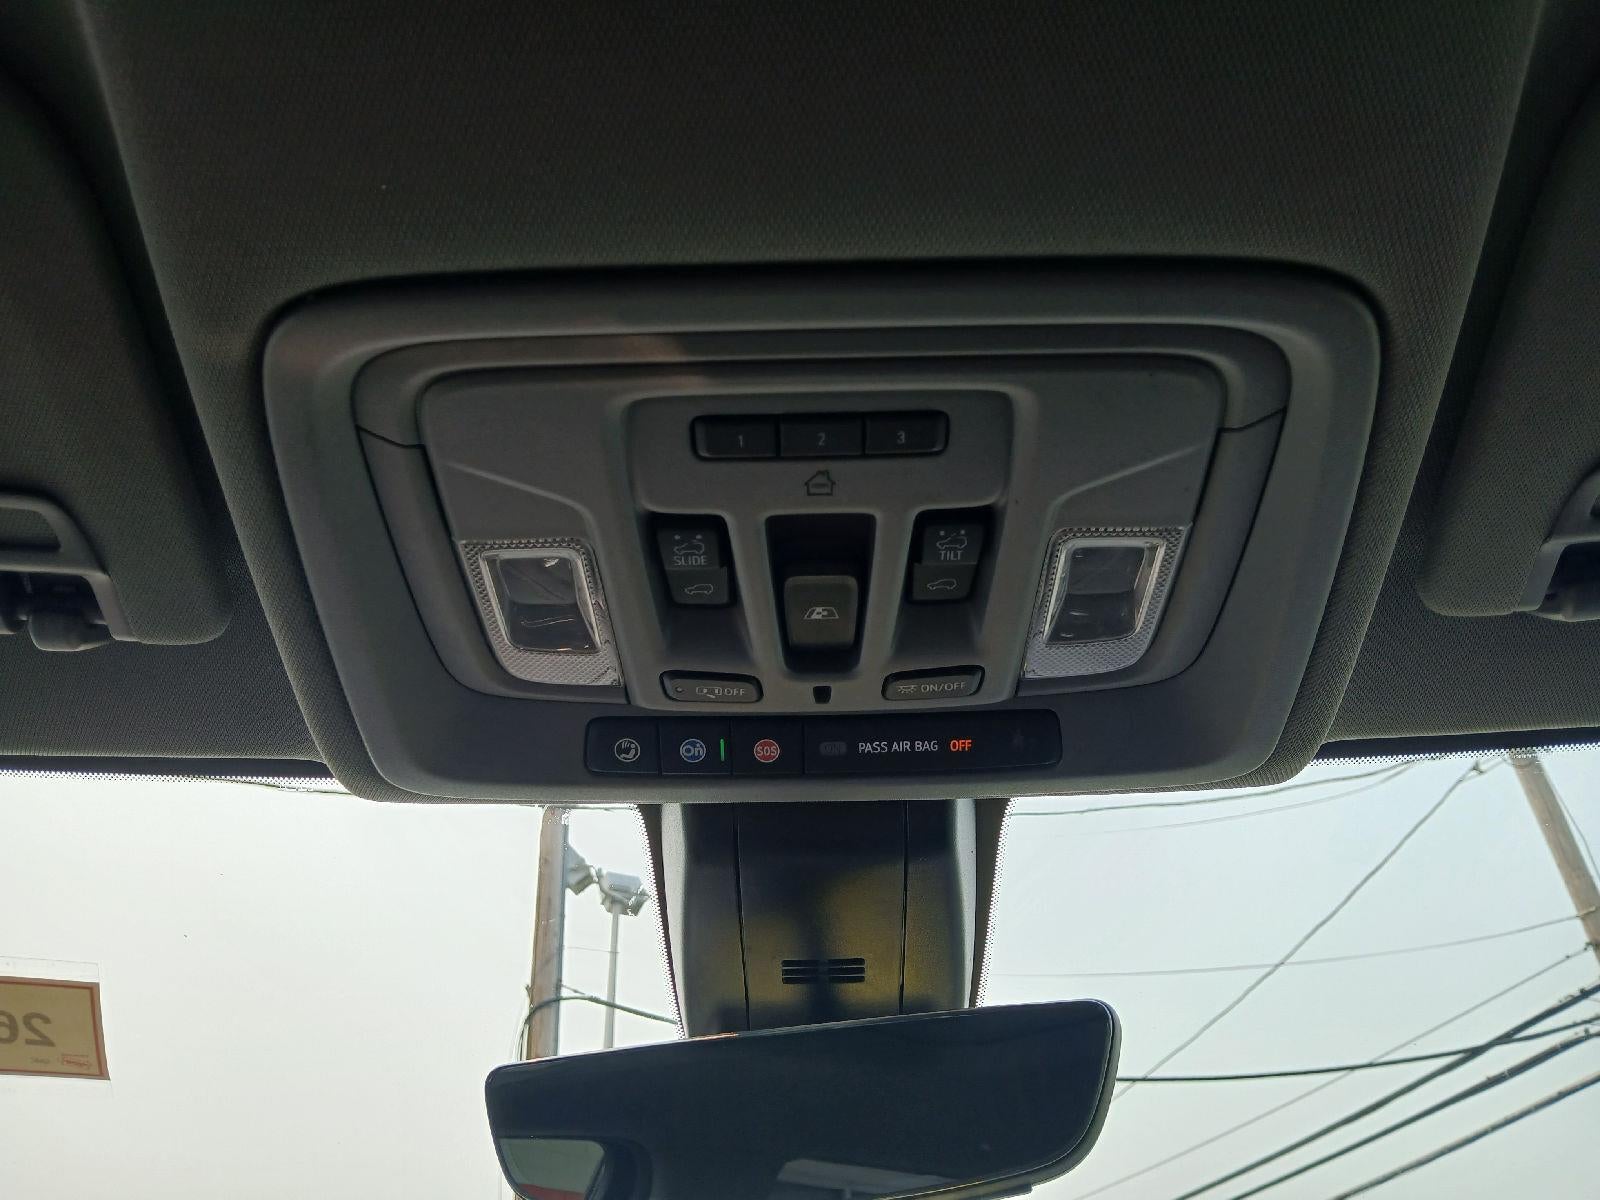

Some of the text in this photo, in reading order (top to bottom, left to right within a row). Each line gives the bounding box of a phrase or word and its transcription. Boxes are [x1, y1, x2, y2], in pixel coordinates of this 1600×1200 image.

[737, 434, 744, 447] 1
[817, 432, 826, 446] 2
[896, 431, 906, 444] 3
[673, 554, 708, 566] SLIDE
[939, 550, 962, 561] TILT
[725, 687, 746, 697] OFF
[921, 681, 967, 694] ON/OFF
[757, 745, 777, 758] SOS
[858, 740, 888, 754] PASS
[891, 740, 912, 753] AIR
[915, 739, 939, 752] BAG
[950, 739, 972, 752] OFF
